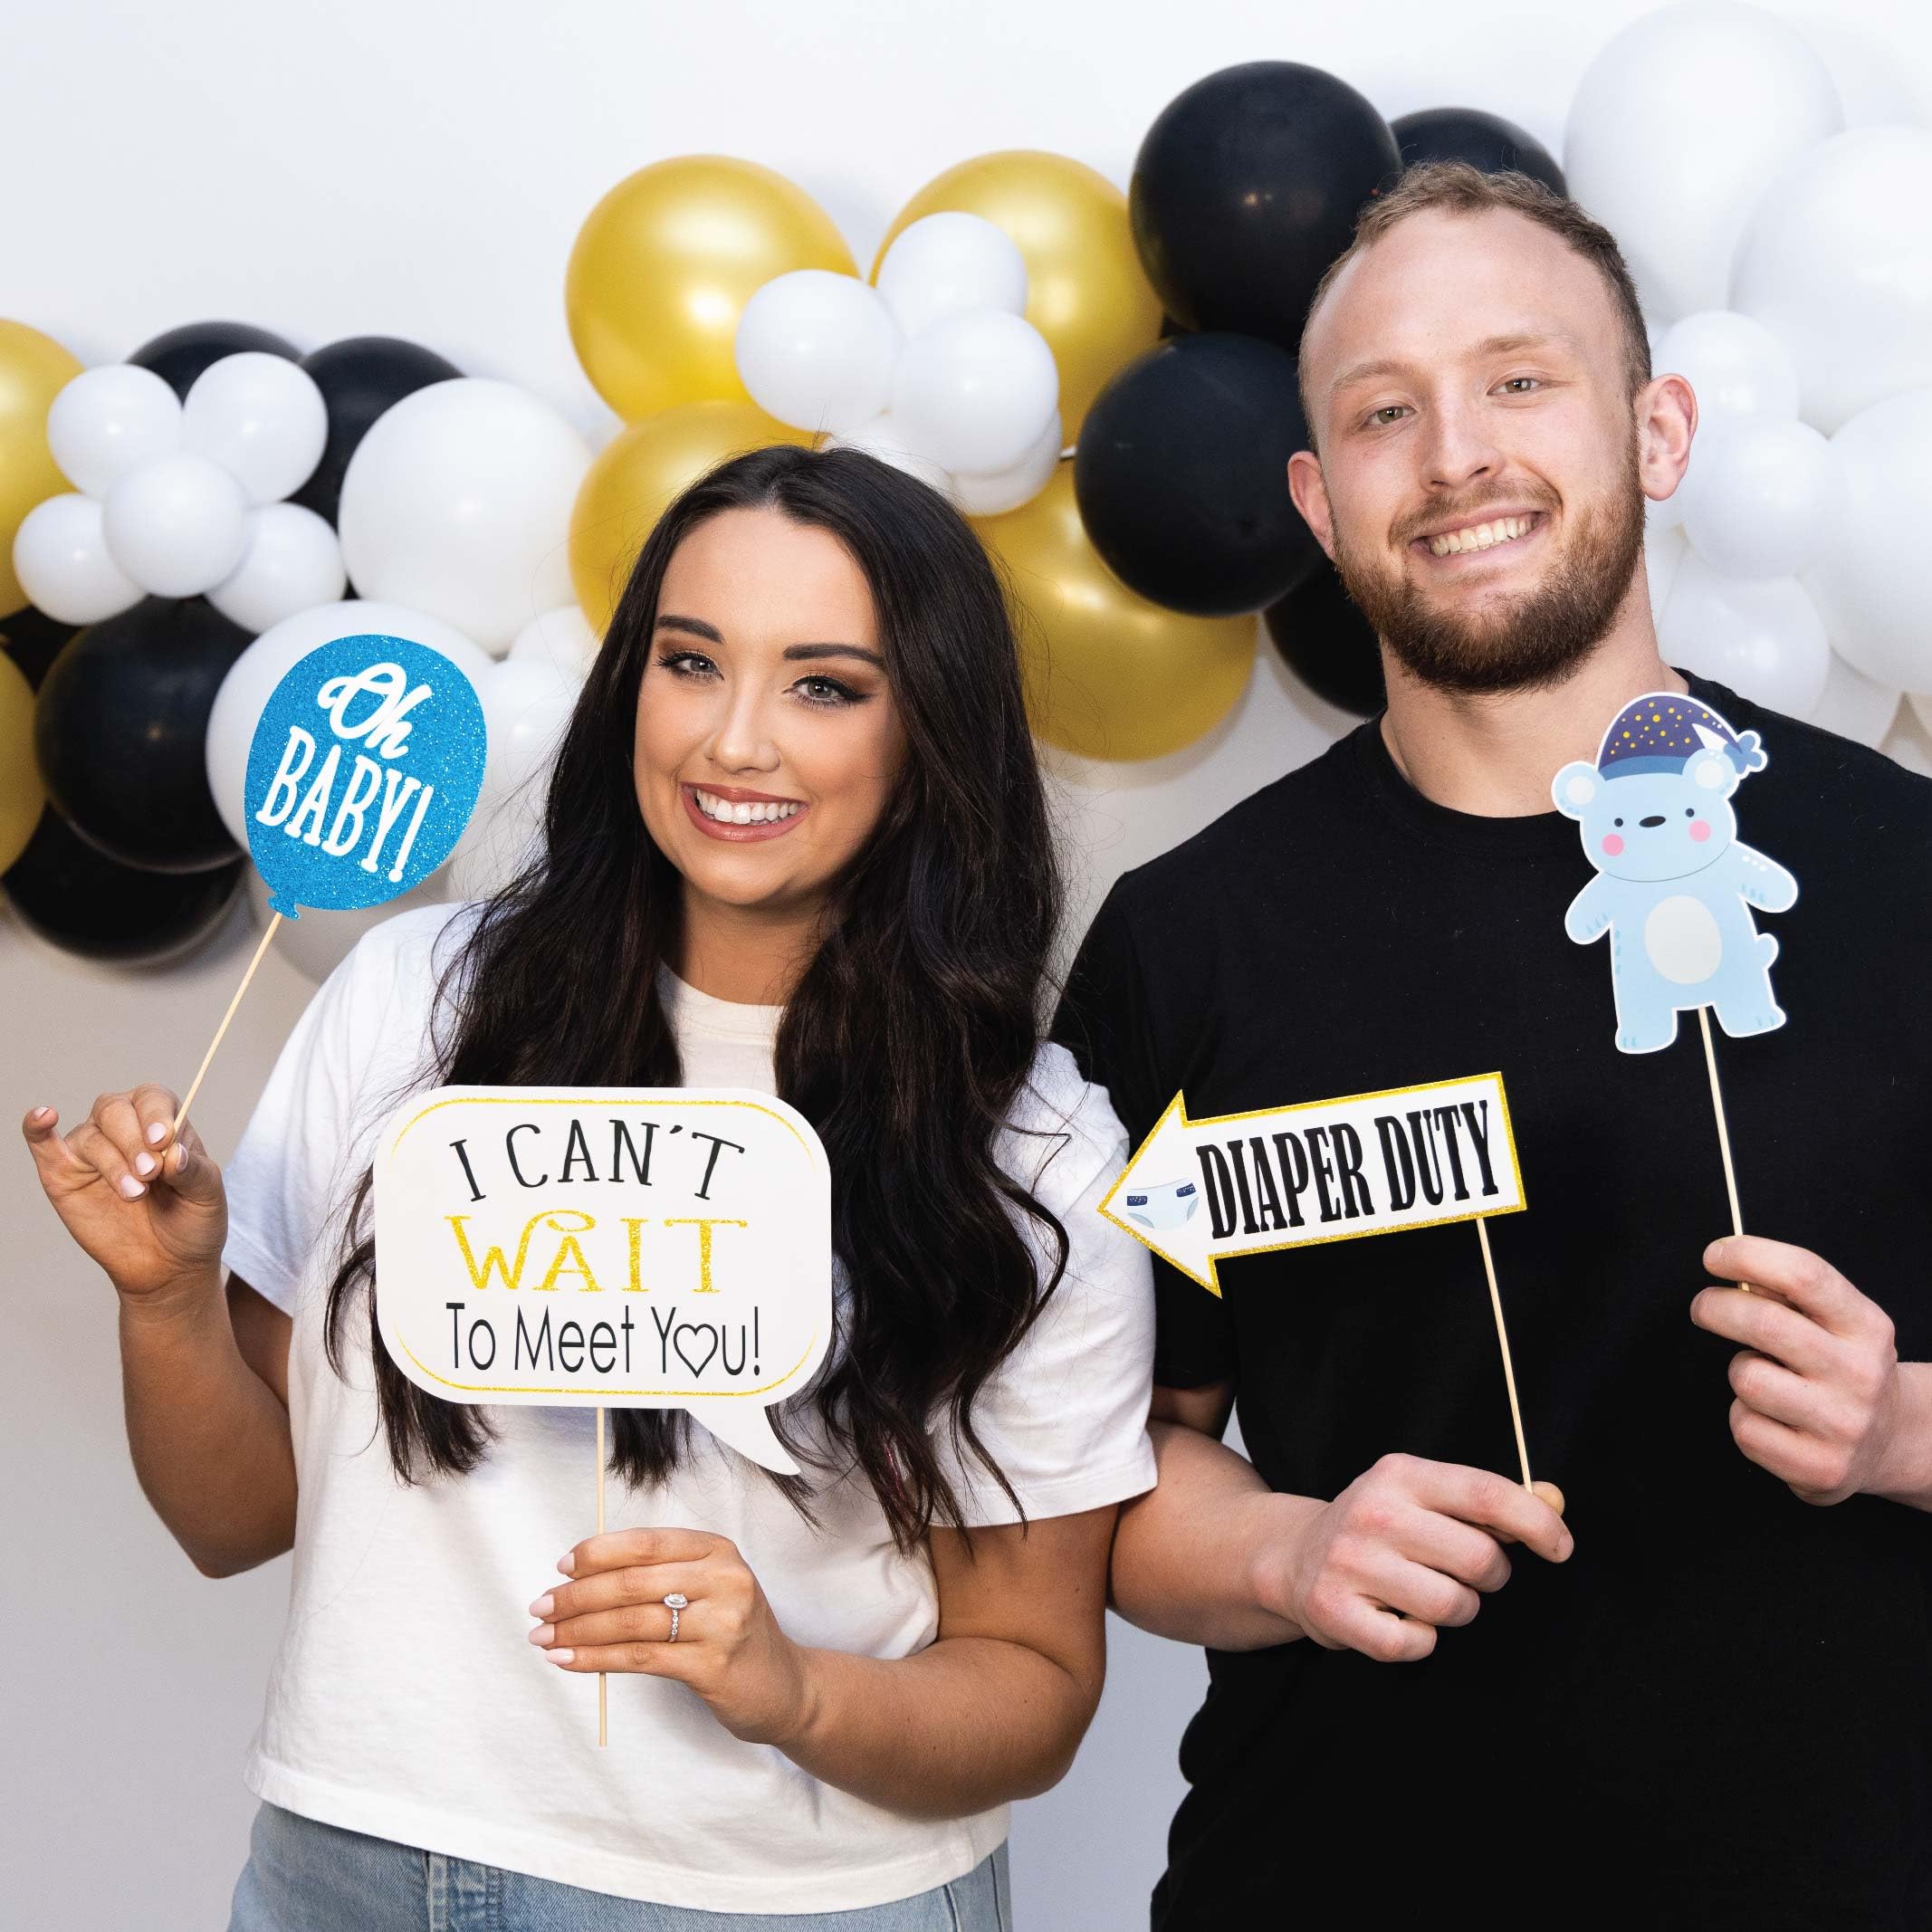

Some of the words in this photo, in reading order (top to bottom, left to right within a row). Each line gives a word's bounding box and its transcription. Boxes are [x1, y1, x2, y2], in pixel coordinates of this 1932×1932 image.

[318, 662, 433, 760] Oh
[255, 725, 435, 883] BABY!
[449, 1138, 487, 1202] I
[505, 1119, 745, 1200] CAN'T
[1196, 1122, 1375, 1240] DIAPER
[1373, 1099, 1499, 1212] DUTY
[444, 1210, 748, 1294] WAIT
[445, 1302, 497, 1372] To
[513, 1304, 635, 1375] Meet
